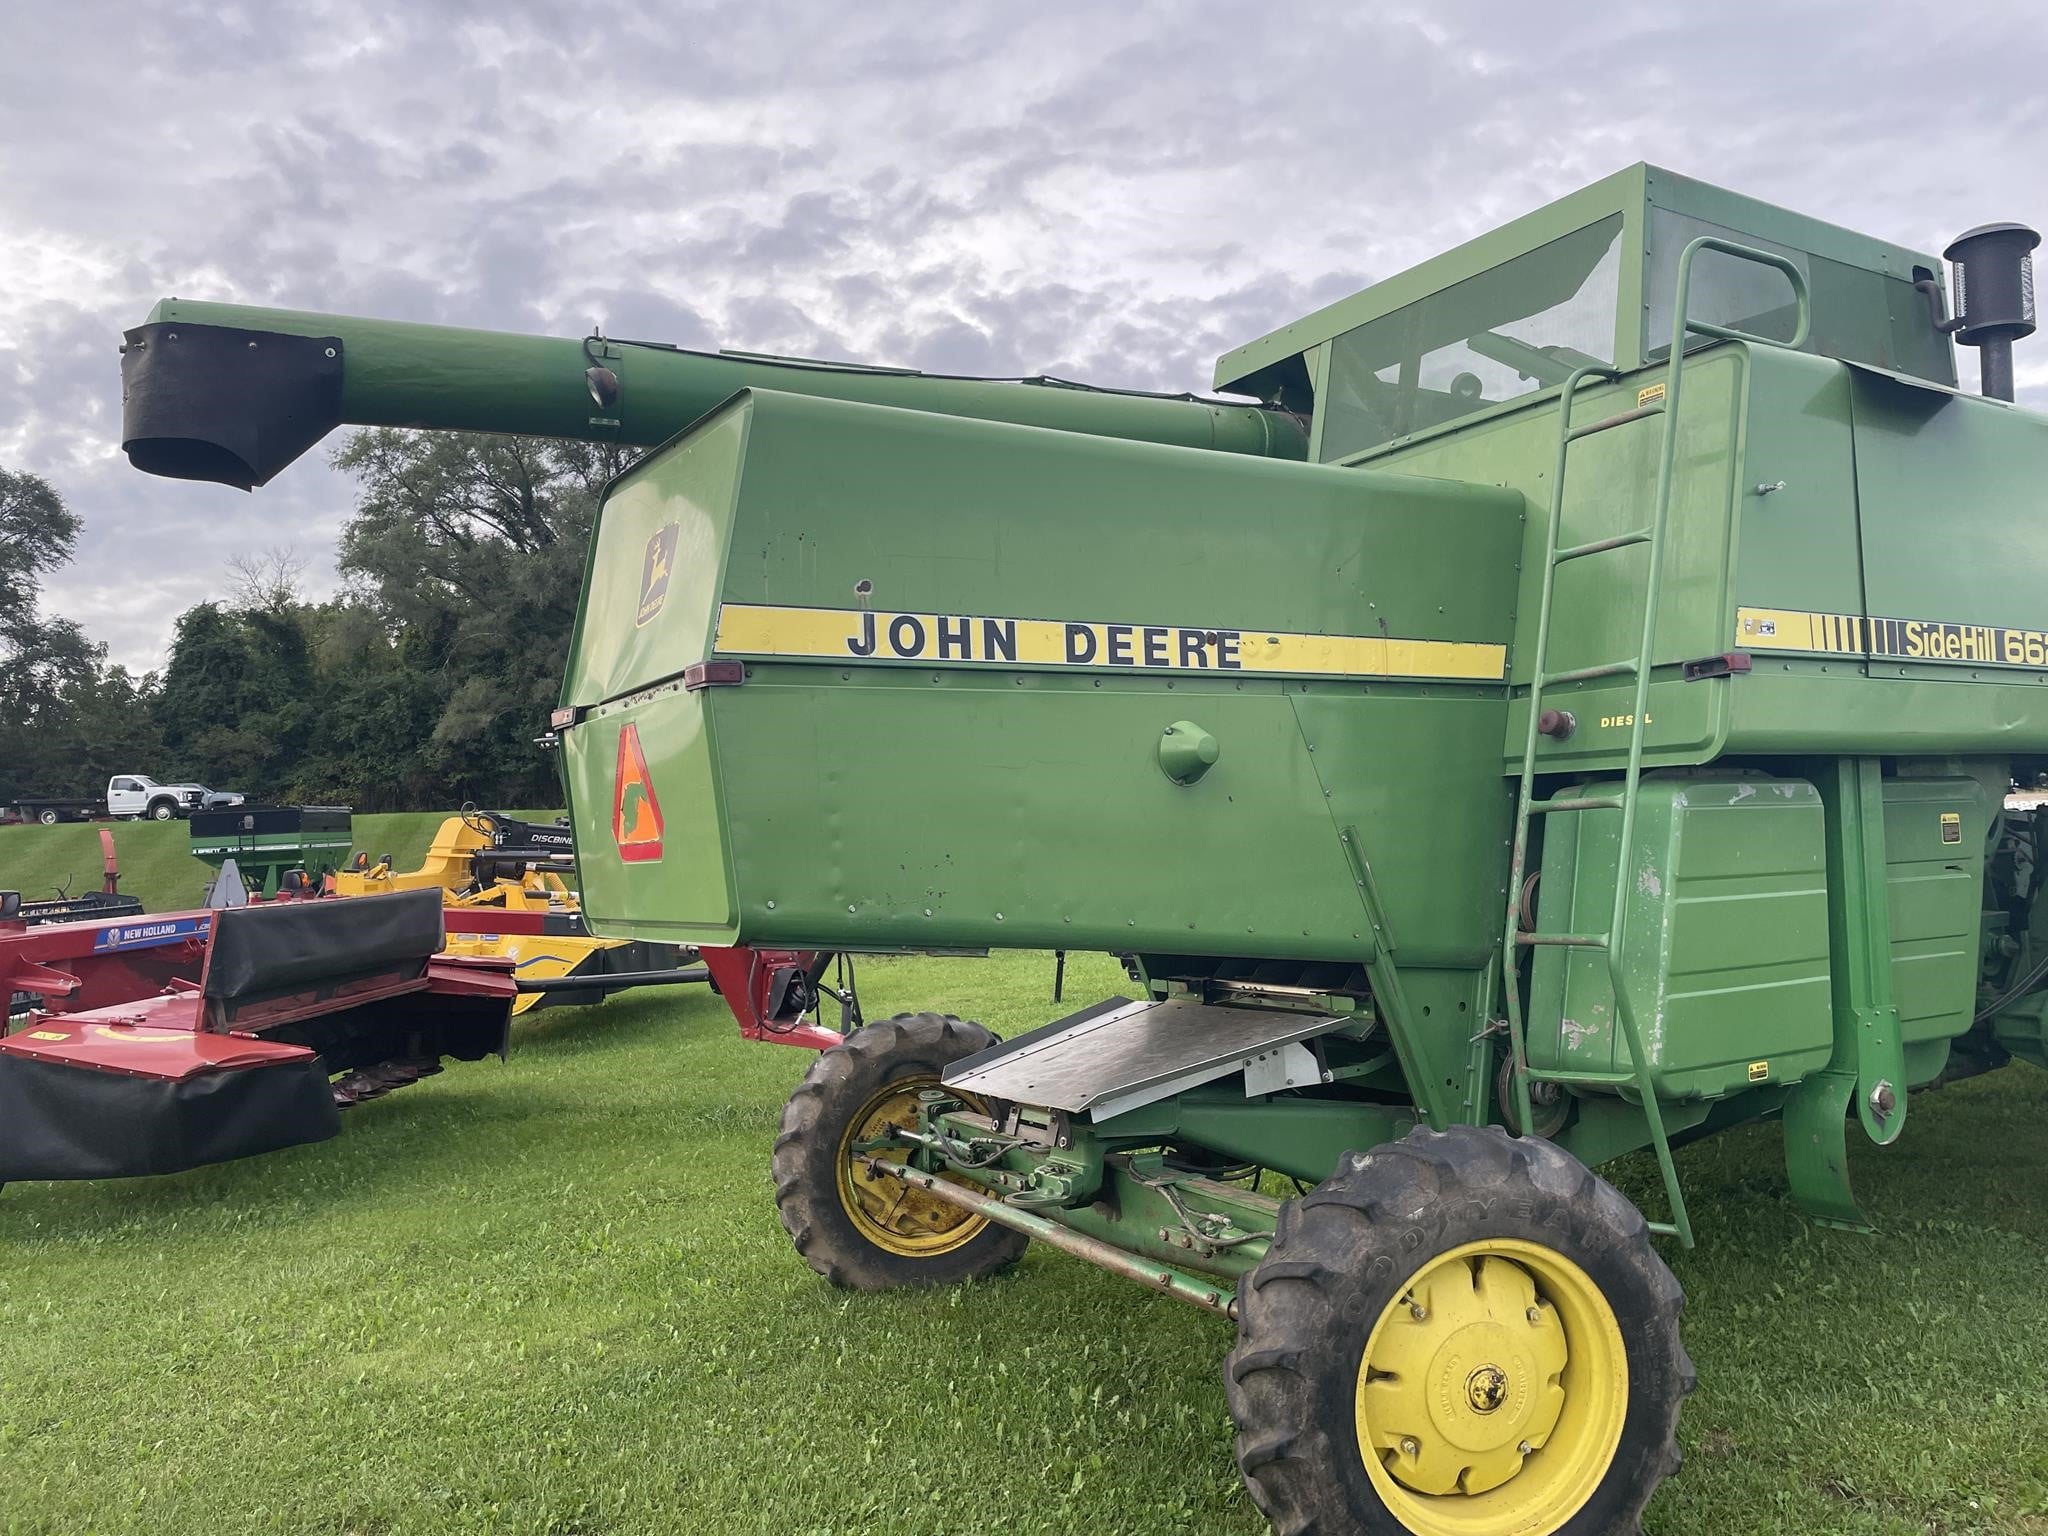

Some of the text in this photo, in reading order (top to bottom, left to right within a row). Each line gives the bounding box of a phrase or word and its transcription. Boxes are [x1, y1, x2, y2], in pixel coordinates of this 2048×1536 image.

[847, 613, 1241, 669] JOHN DEERE
[1906, 621, 2048, 666] SideHill 66
[1601, 713, 1652, 728] DIESL
[124, 924, 176, 940] NEW HOLLAND
